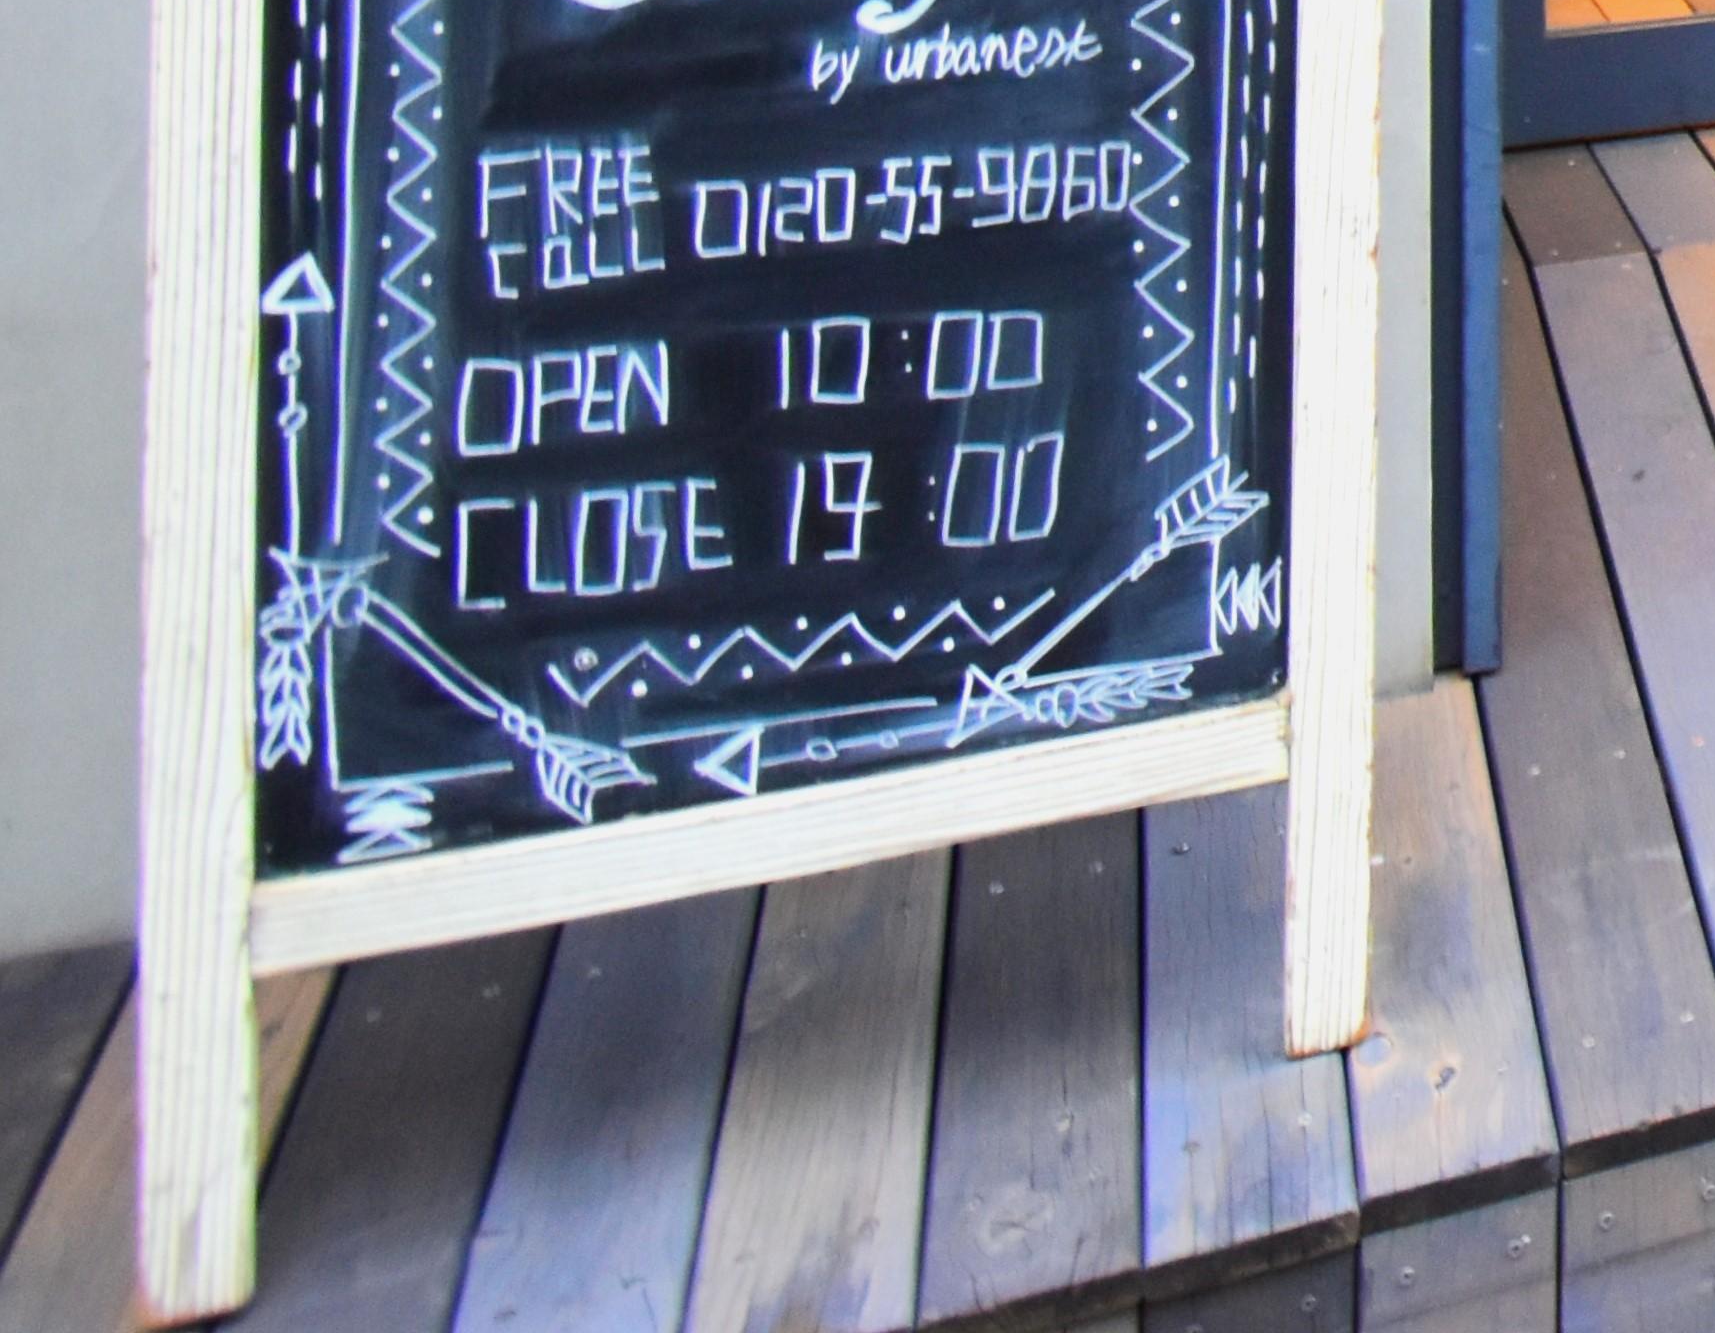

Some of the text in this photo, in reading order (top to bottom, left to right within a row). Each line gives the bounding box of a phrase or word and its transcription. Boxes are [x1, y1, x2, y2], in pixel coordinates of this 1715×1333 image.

[810, 37, 858, 101] by
[480, 145, 663, 241] FREE
[692, 141, 1133, 261] 0120-55-9860
[487, 226, 667, 299] CALL
[456, 340, 673, 456] OPEN
[455, 479, 733, 611] CLOSE
